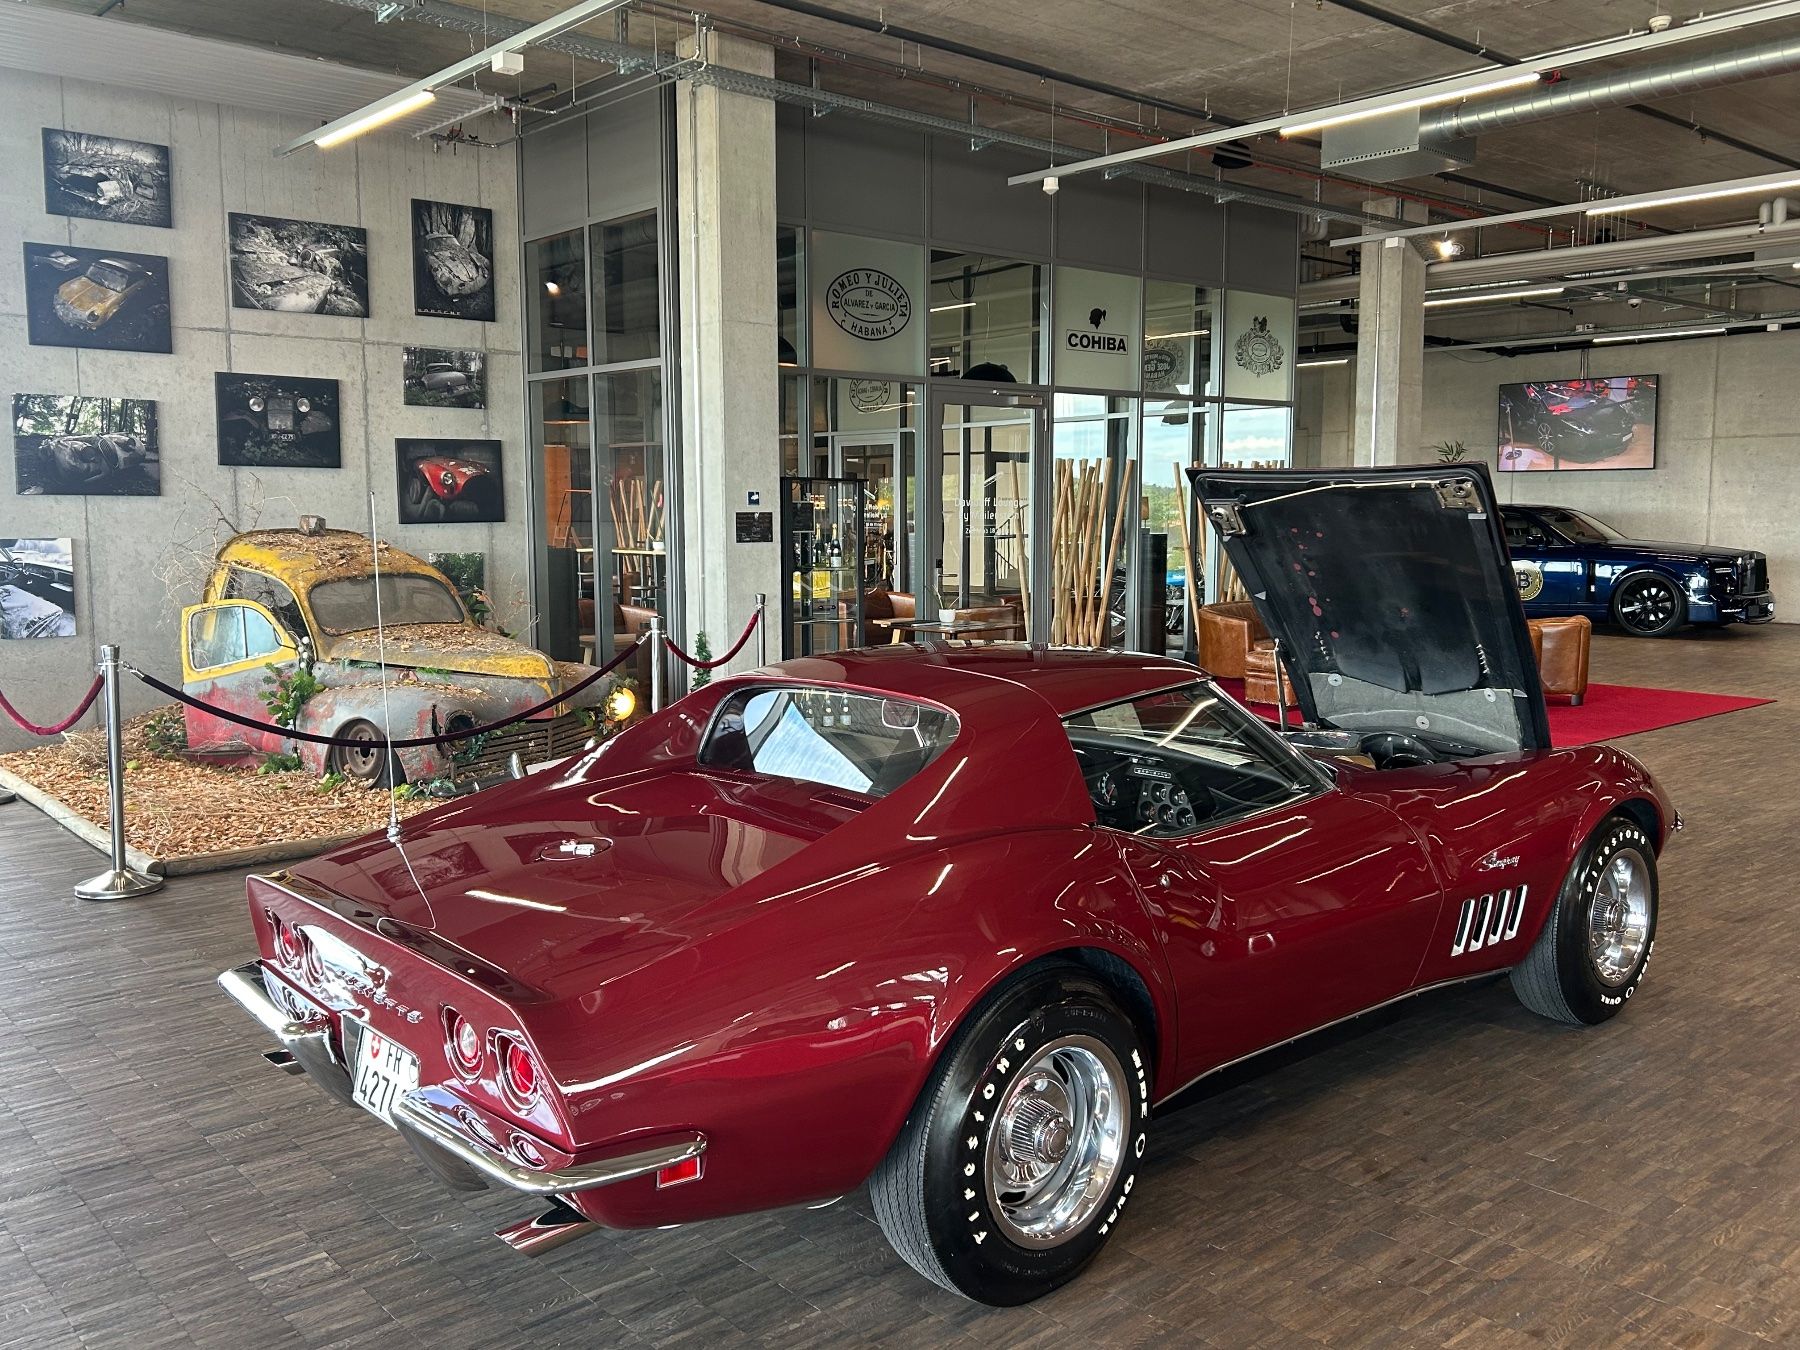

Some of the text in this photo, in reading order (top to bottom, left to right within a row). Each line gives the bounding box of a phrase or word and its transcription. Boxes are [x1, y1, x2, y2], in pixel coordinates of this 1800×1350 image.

[832, 272, 908, 317] ROMEO Y JULIETA
[865, 289, 873, 297] DE
[844, 298, 870, 309] ALVAREZ
[850, 321, 888, 337] HABANA
[1067, 332, 1127, 352] COHIBA
[1130, 1048, 1148, 1119] WIDE
[1098, 1174, 1135, 1235] OVAL
